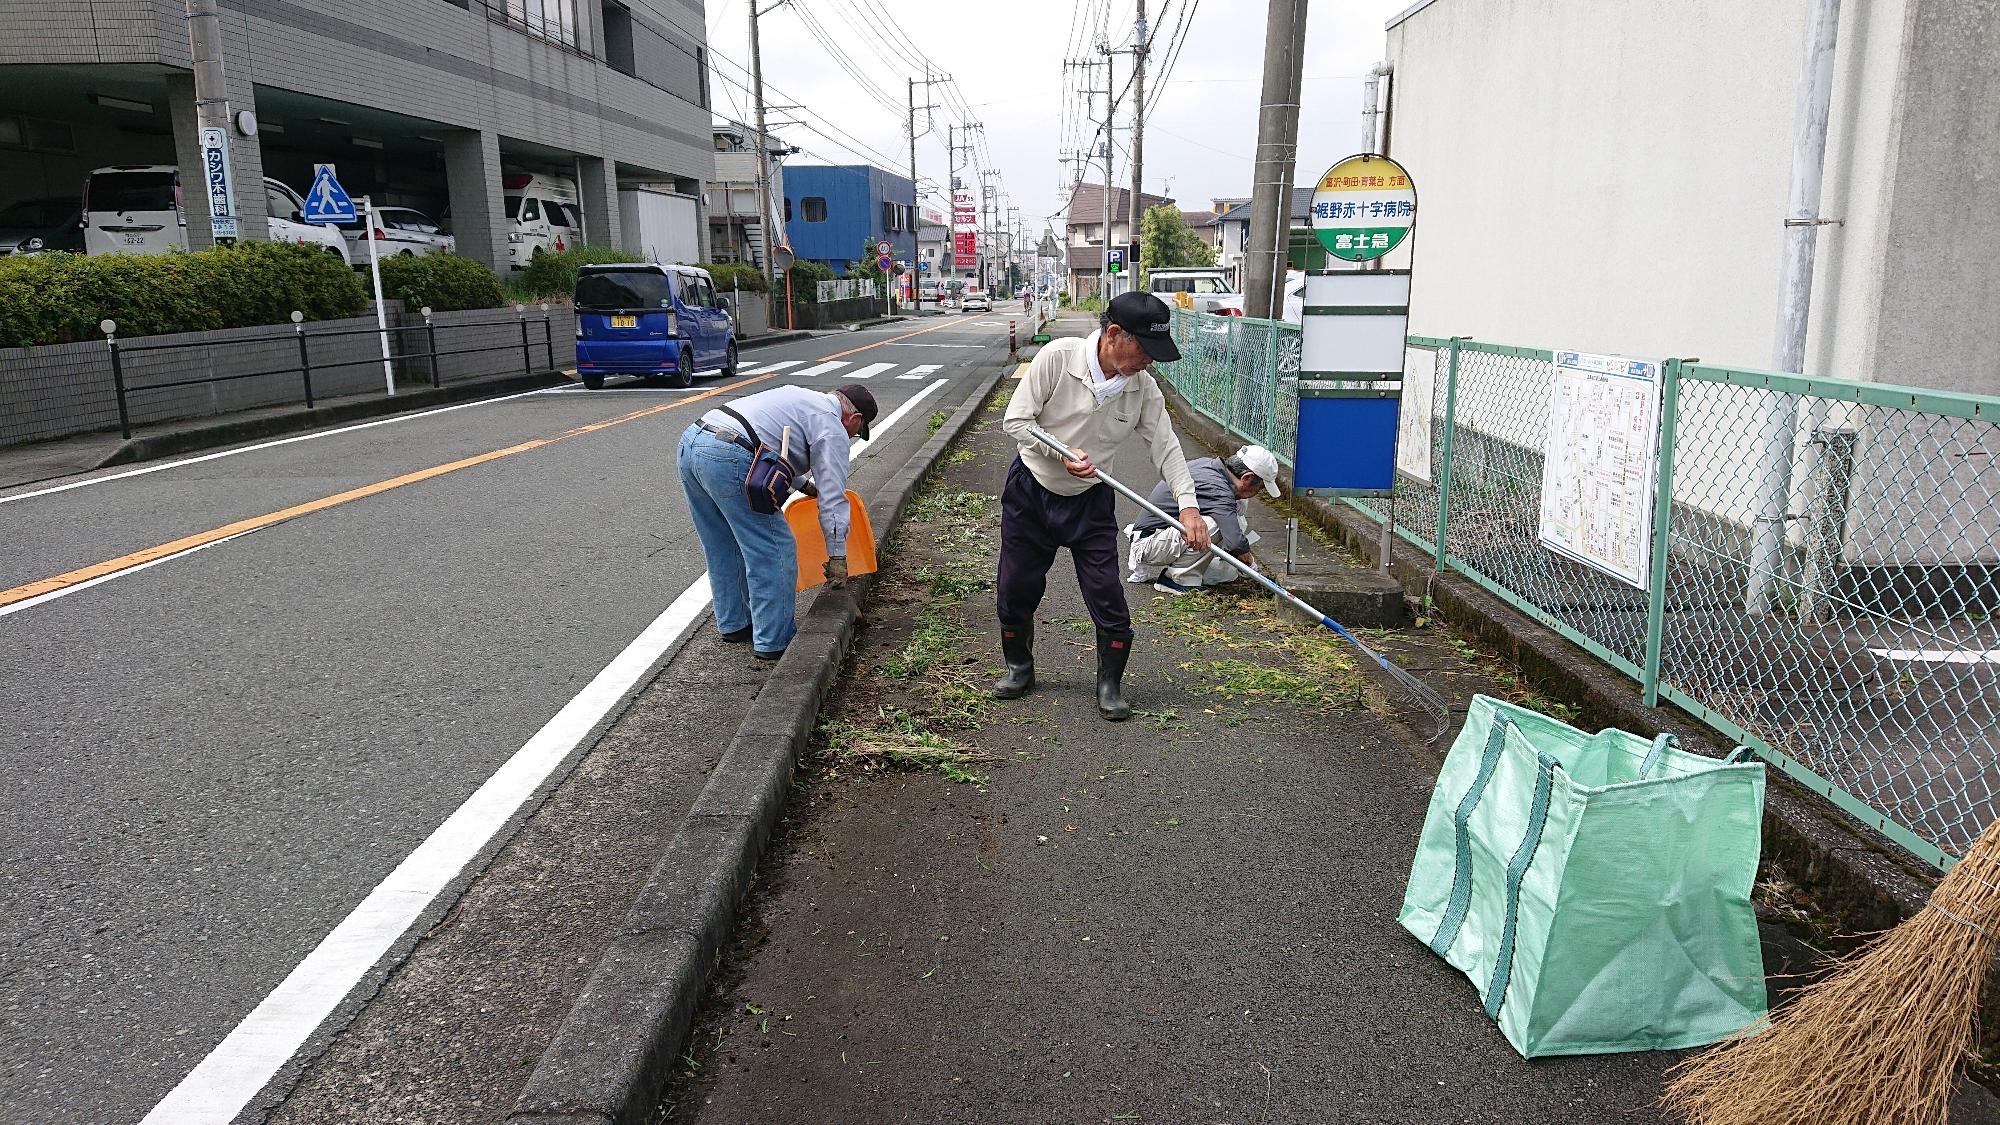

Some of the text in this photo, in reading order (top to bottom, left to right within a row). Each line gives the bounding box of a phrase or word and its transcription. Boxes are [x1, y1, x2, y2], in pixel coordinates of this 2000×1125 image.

[208, 151, 228, 216] カシワ木歯科
[1388, 175, 1406, 186] 方面
[1316, 200, 1411, 219] 裾野赤十字病院
[1335, 233, 1389, 249] 富士急
[1110, 252, 1120, 262] P
